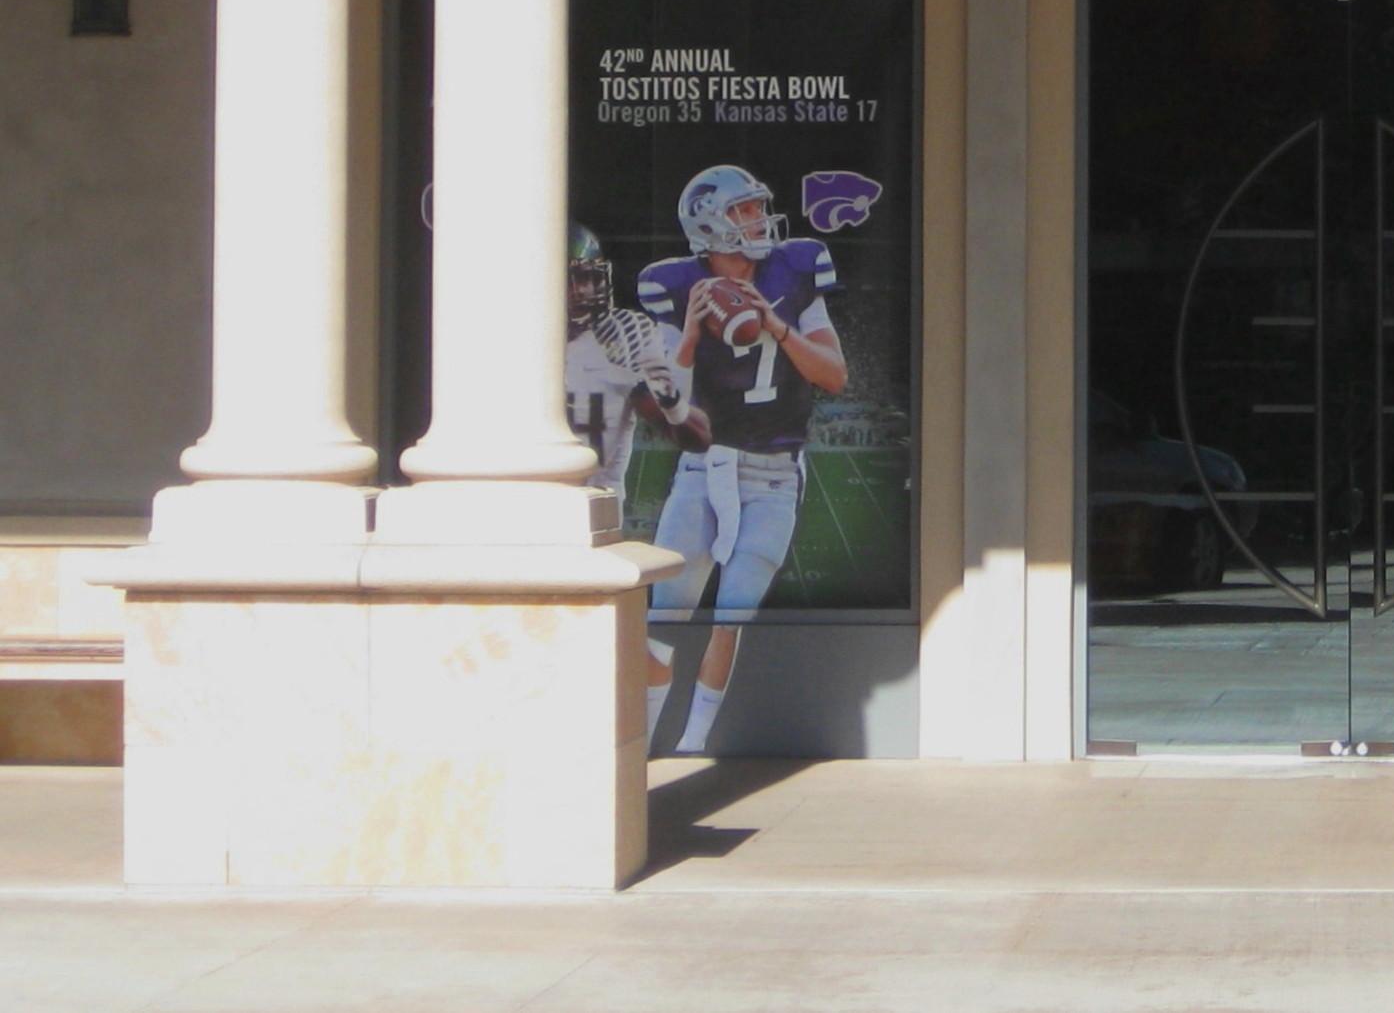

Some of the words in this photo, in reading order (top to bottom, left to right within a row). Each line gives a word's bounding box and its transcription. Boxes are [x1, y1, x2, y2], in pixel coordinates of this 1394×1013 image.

[600, 48, 644, 72] 42ND
[650, 49, 736, 72] ANNUAL
[600, 76, 700, 100] TOSTITOS
[707, 76, 781, 100] FIESTA
[788, 76, 850, 99] BOWL
[598, 100, 671, 127] Oregon
[676, 100, 702, 122] 35
[715, 100, 787, 122] Kansas
[794, 100, 849, 122] State
[857, 100, 878, 122] 17
